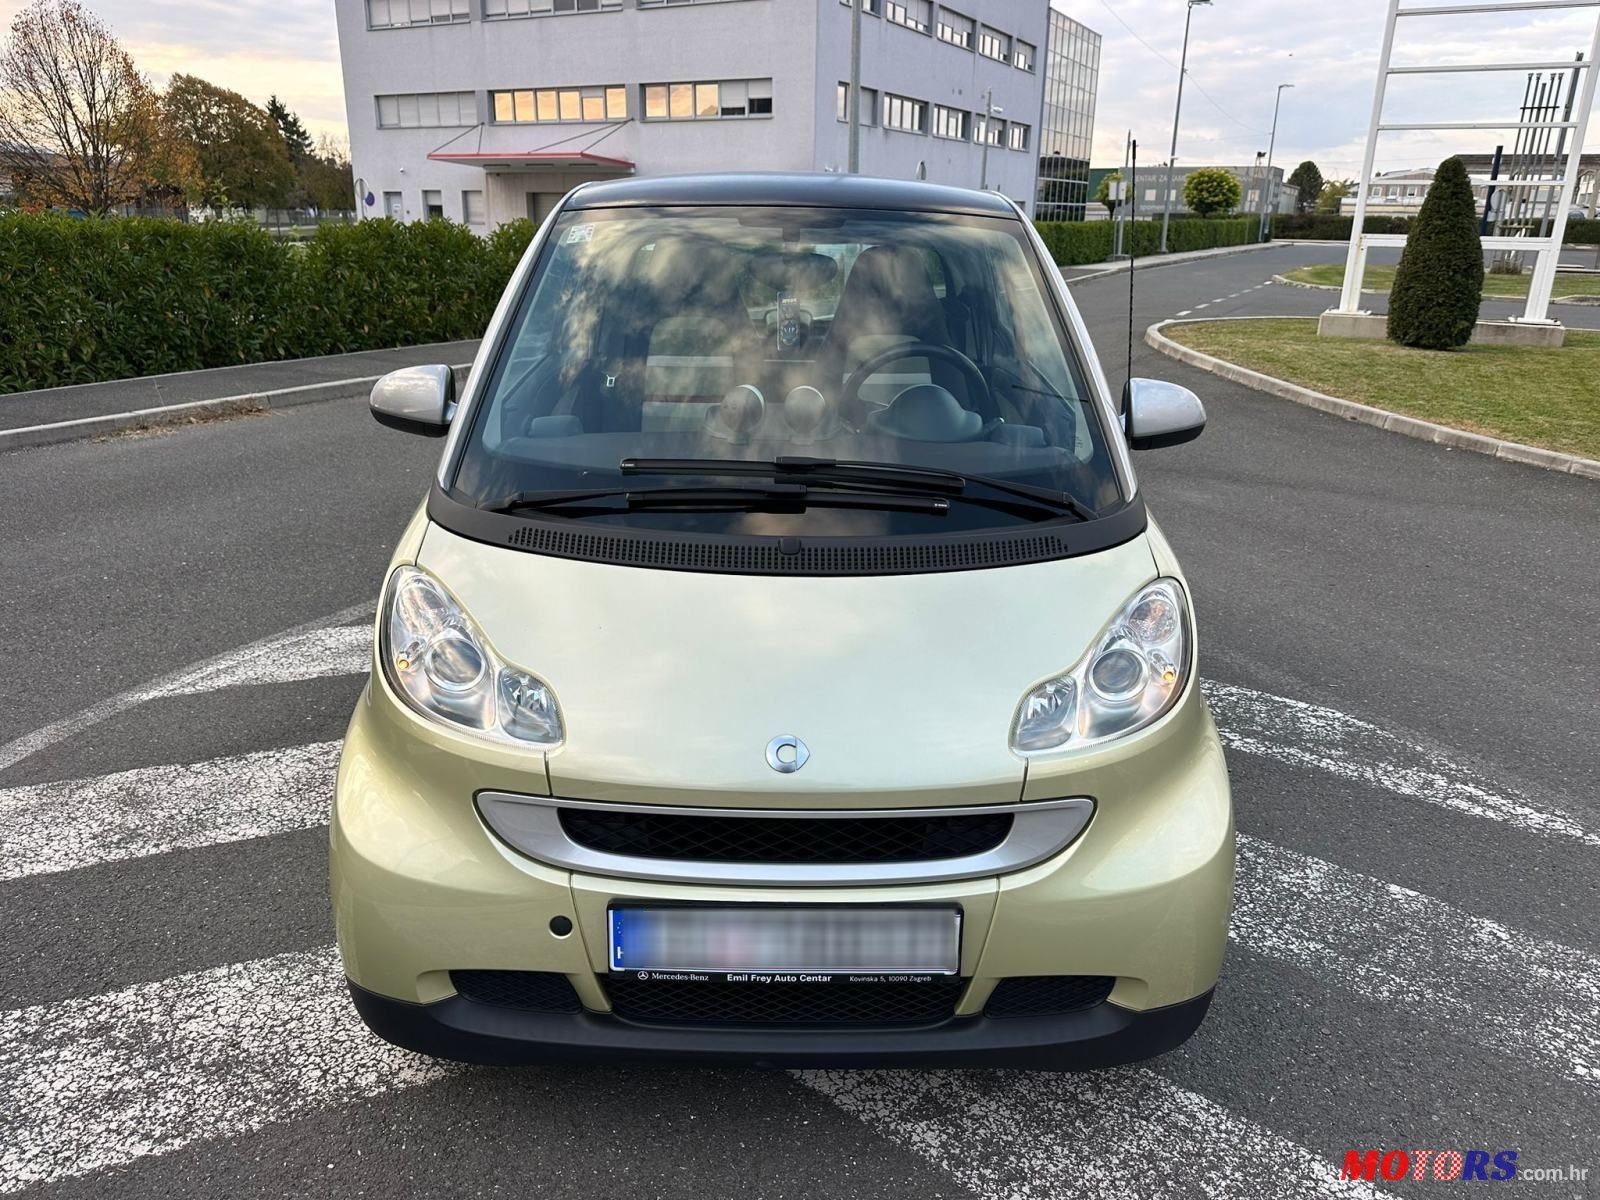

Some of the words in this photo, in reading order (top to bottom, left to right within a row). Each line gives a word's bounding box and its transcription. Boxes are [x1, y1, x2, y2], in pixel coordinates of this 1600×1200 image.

[651, 972, 709, 982] Mercedes-Benz
[727, 974, 748, 982] Emil
[750, 974, 772, 984] Frey
[774, 975, 797, 983] Auto
[799, 974, 832, 983] Centar
[909, 976, 932, 984] Zagreb
